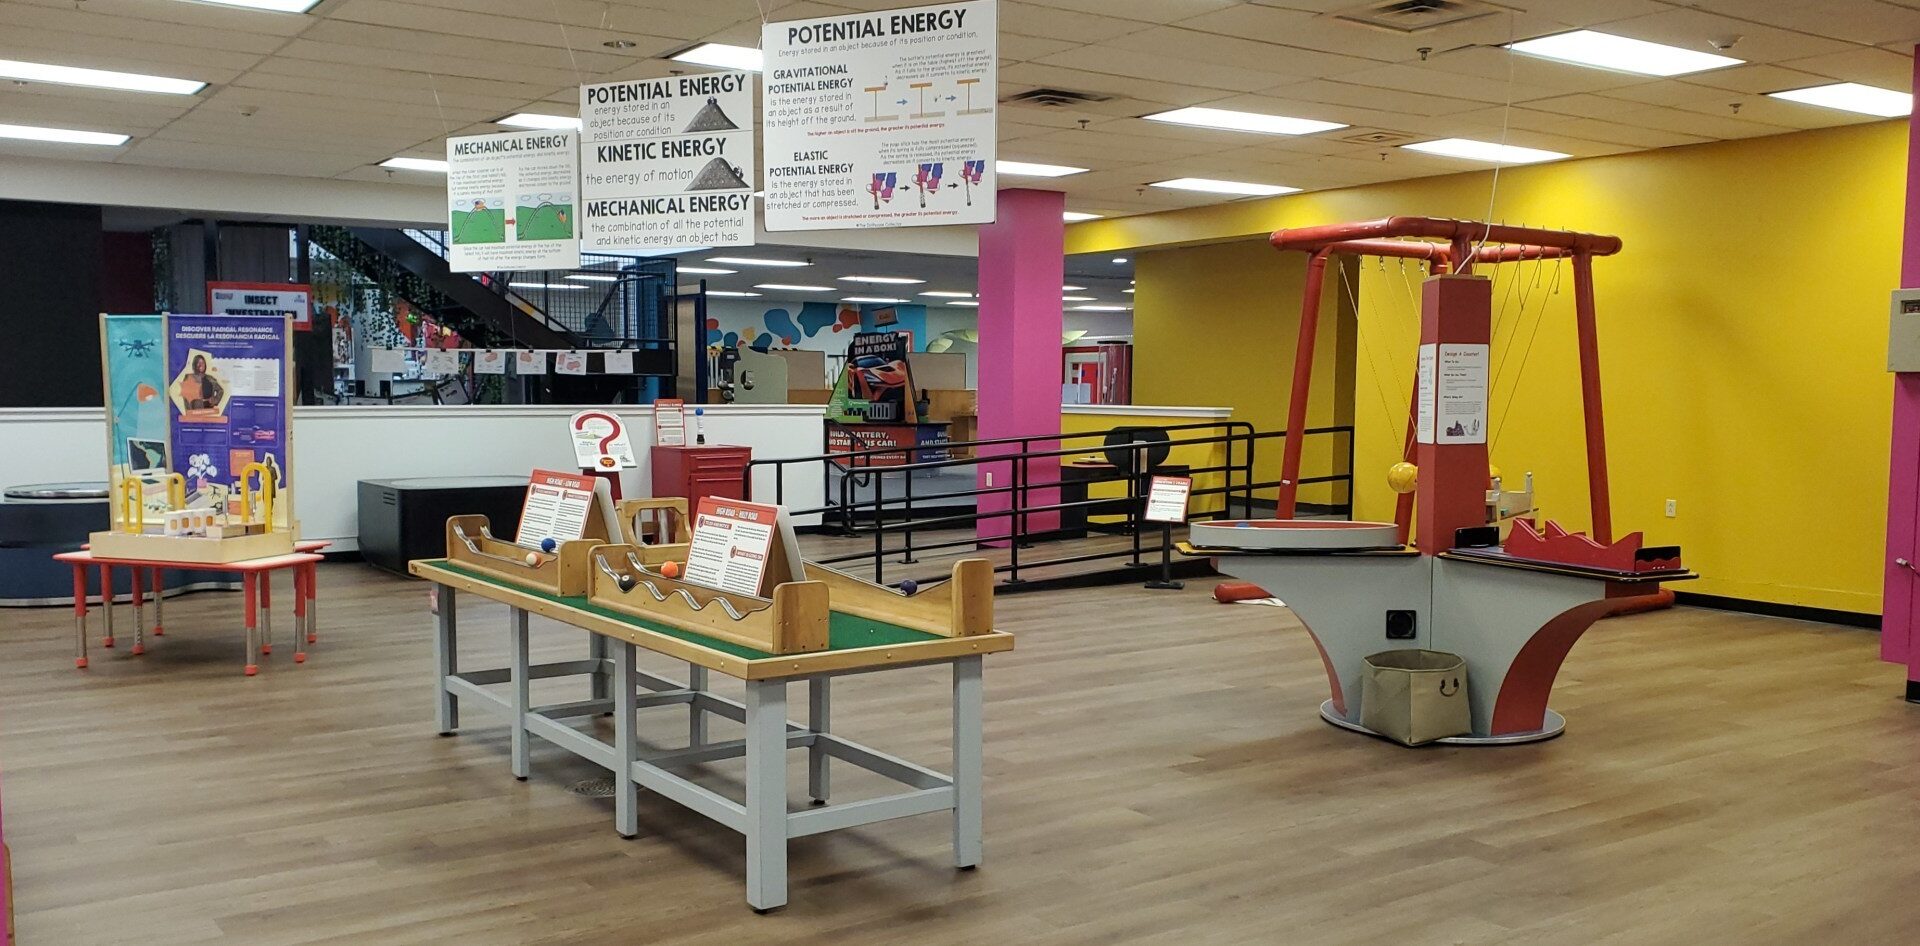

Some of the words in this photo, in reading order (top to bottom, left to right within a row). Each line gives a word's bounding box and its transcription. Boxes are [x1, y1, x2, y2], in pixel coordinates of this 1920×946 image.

[788, 18, 885, 45] POTENTIAL
[890, 9, 967, 35] ENERGY
[778, 49, 799, 58] Energy
[800, 45, 822, 55] stored
[823, 45, 828, 53] in
[839, 43, 859, 52] object
[861, 41, 888, 49] because
[889, 38, 897, 46] of
[900, 37, 908, 45] its
[910, 36, 936, 47] position
[946, 31, 978, 41] condition.
[774, 64, 848, 79] GRAVITATIONAL
[588, 80, 673, 105] POTENTIAL
[680, 74, 746, 97] ENERGY
[769, 82, 815, 94] POTENTIAL
[818, 78, 853, 90] ENERGY
[771, 98, 776, 106] is
[779, 97, 790, 105] the
[793, 96, 816, 105] energy
[820, 93, 843, 102] stored
[595, 105, 621, 116] energy
[624, 101, 649, 112] stored
[652, 101, 658, 110] in
[660, 101, 670, 109] an
[778, 107, 801, 116] object
[821, 103, 843, 113] result
[590, 117, 615, 129] object
[617, 115, 650, 126] because
[653, 114, 661, 123] of
[664, 113, 675, 122] its
[777, 117, 799, 127] height
[801, 117, 813, 125] off
[816, 116, 828, 124] the
[830, 114, 856, 124] ground.
[594, 130, 624, 141] position
[626, 129, 634, 137] or
[636, 126, 671, 137] condition
[455, 139, 523, 155] MECHANICAL
[526, 135, 568, 150] ENERGY
[597, 142, 656, 163] KINETIC
[662, 137, 726, 159] ENERGY
[794, 150, 828, 161] ELASTIC
[586, 173, 602, 185] the
[606, 172, 640, 185] energy
[644, 170, 655, 182] of
[659, 168, 693, 181] motion
[769, 166, 816, 177] POTENTIAL
[819, 164, 854, 175] ENERGY
[794, 180, 817, 188] energy
[820, 178, 844, 186] stored
[780, 190, 802, 200] object
[805, 189, 819, 197] that
[838, 188, 854, 196] been
[587, 198, 685, 218] MECHANICAL
[690, 194, 750, 212] ENERGY
[767, 201, 801, 209] stretched
[813, 198, 858, 209] compressed.
[591, 222, 606, 232] the
[608, 220, 657, 232] combination
[660, 220, 670, 230] of
[674, 219, 683, 229] all
[686, 219, 700, 228] the
[704, 217, 744, 229] potential
[597, 236, 611, 246] and
[614, 235, 641, 244] kinetic
[644, 235, 673, 246] energy
[677, 234, 687, 243] an
[690, 233, 718, 244] object
[722, 232, 738, 242] has
[244, 295, 278, 305] INSECT
[855, 334, 896, 346] ENERGY
[855, 347, 864, 355] IN
[874, 343, 897, 353] BOX!
